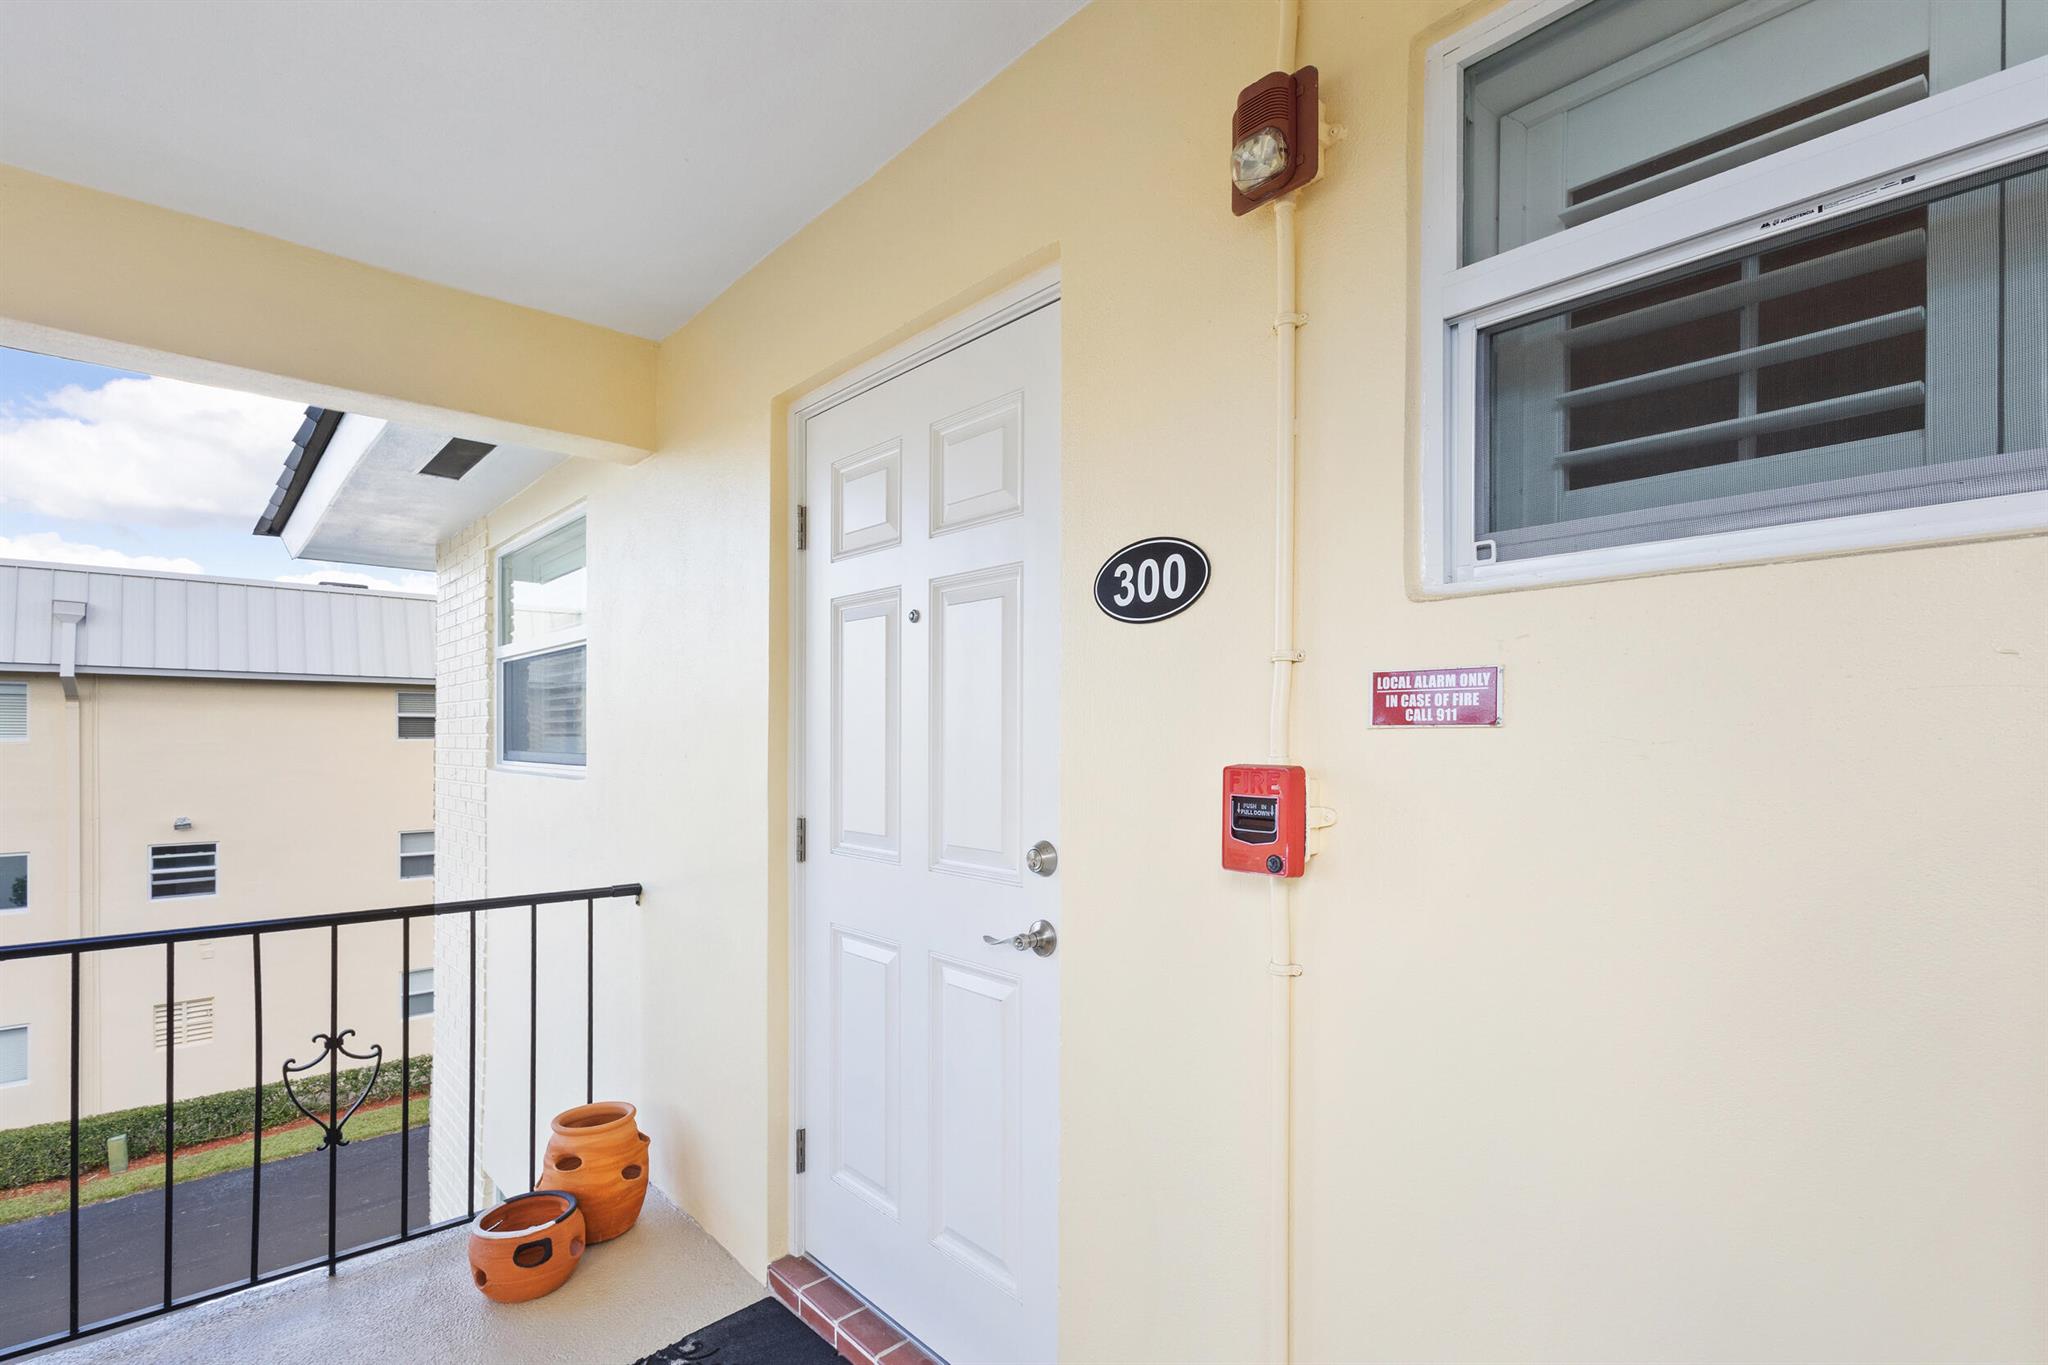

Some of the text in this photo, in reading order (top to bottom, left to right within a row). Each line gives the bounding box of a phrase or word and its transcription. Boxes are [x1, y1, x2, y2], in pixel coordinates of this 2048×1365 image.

[1113, 553, 1187, 607] 300
[1377, 672, 1491, 690] LOCAL ALARM ONLY
[1385, 692, 1480, 708] IN CASE OF FIRE
[1405, 708, 1458, 721] CALL 911
[1230, 771, 1281, 795] FIRE
[1240, 808, 1254, 816] PULL
